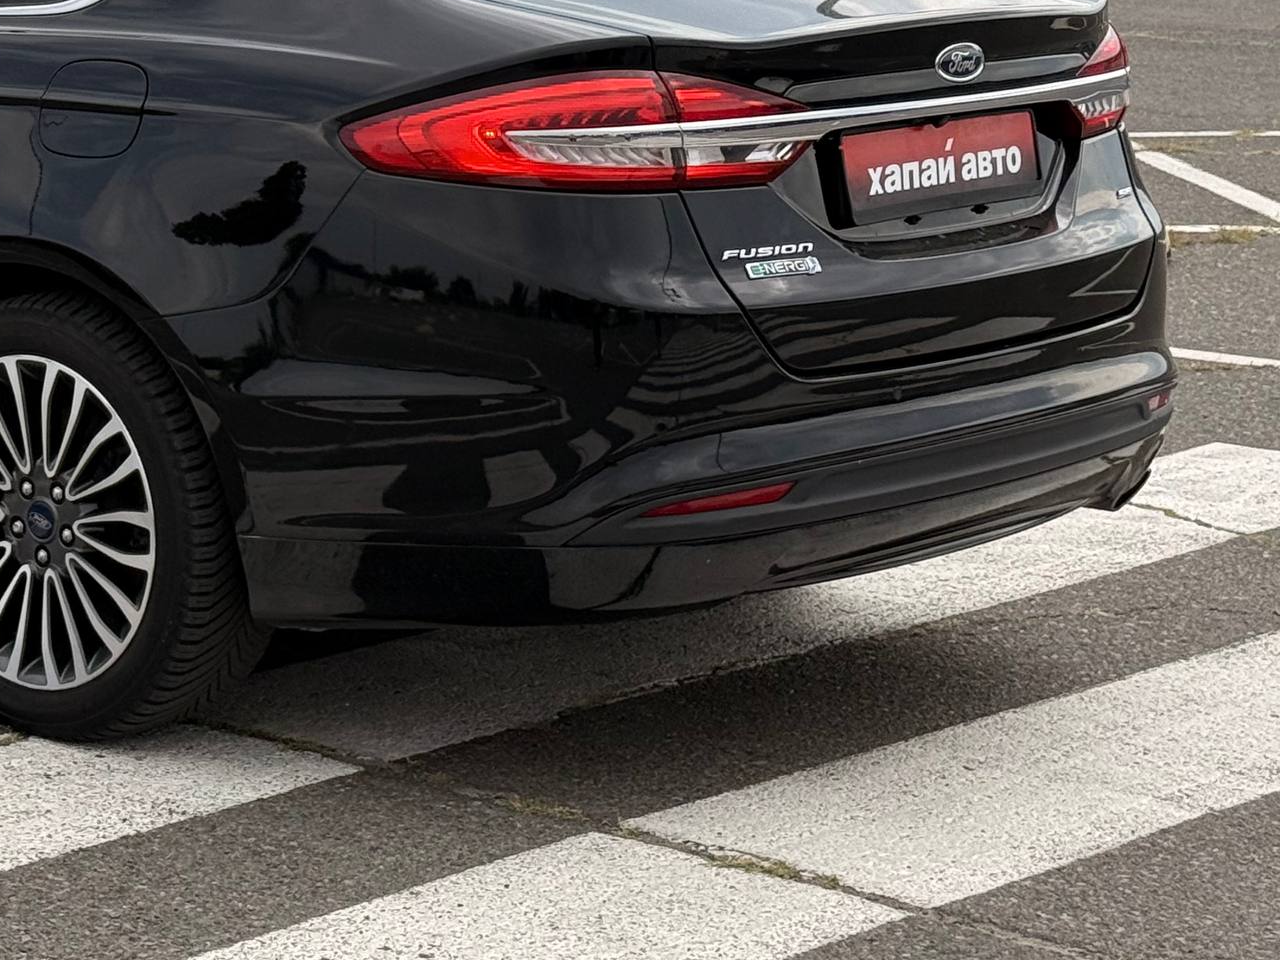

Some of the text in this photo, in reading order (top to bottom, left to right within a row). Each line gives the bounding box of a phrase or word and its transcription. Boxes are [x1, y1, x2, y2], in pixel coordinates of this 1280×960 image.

[949, 51, 977, 73] Ford
[961, 145, 1022, 181] авто
[722, 242, 814, 261] FUSION
